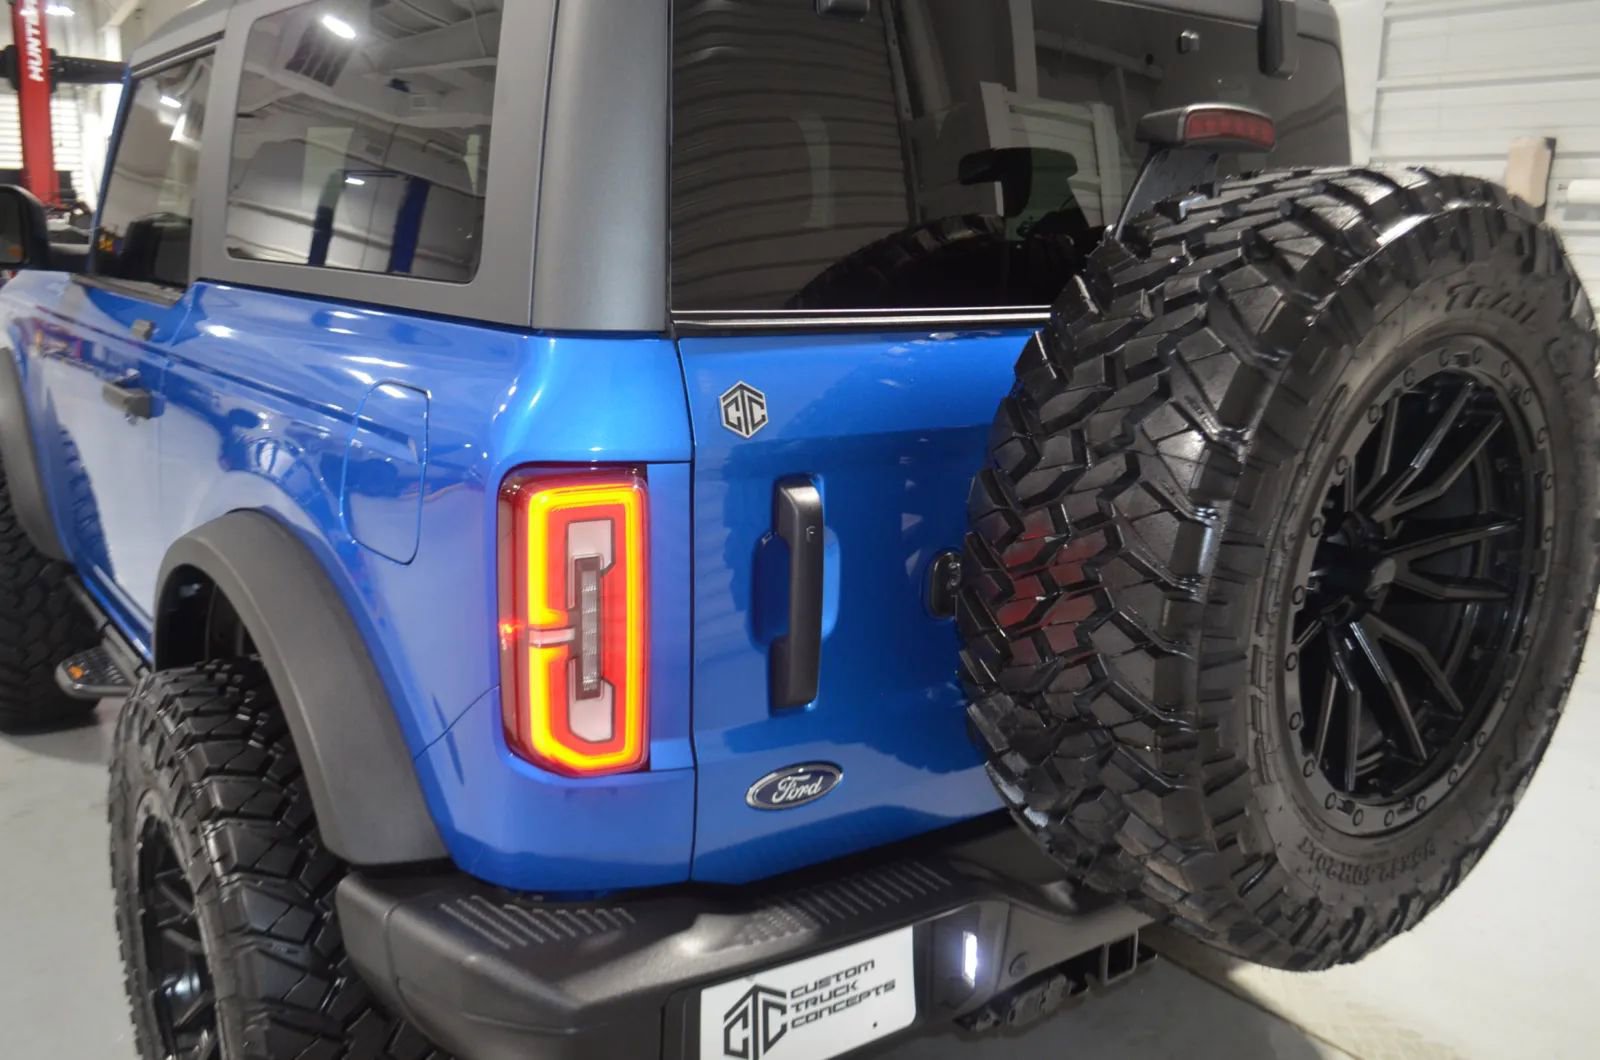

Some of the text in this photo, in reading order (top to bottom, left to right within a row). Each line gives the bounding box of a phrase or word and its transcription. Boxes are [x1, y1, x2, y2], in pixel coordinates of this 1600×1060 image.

[772, 774, 824, 804] Ford
[790, 959, 875, 999] CUSTOM
[791, 979, 859, 1013] TRUCK
[791, 979, 896, 1029] CONCEPTS
